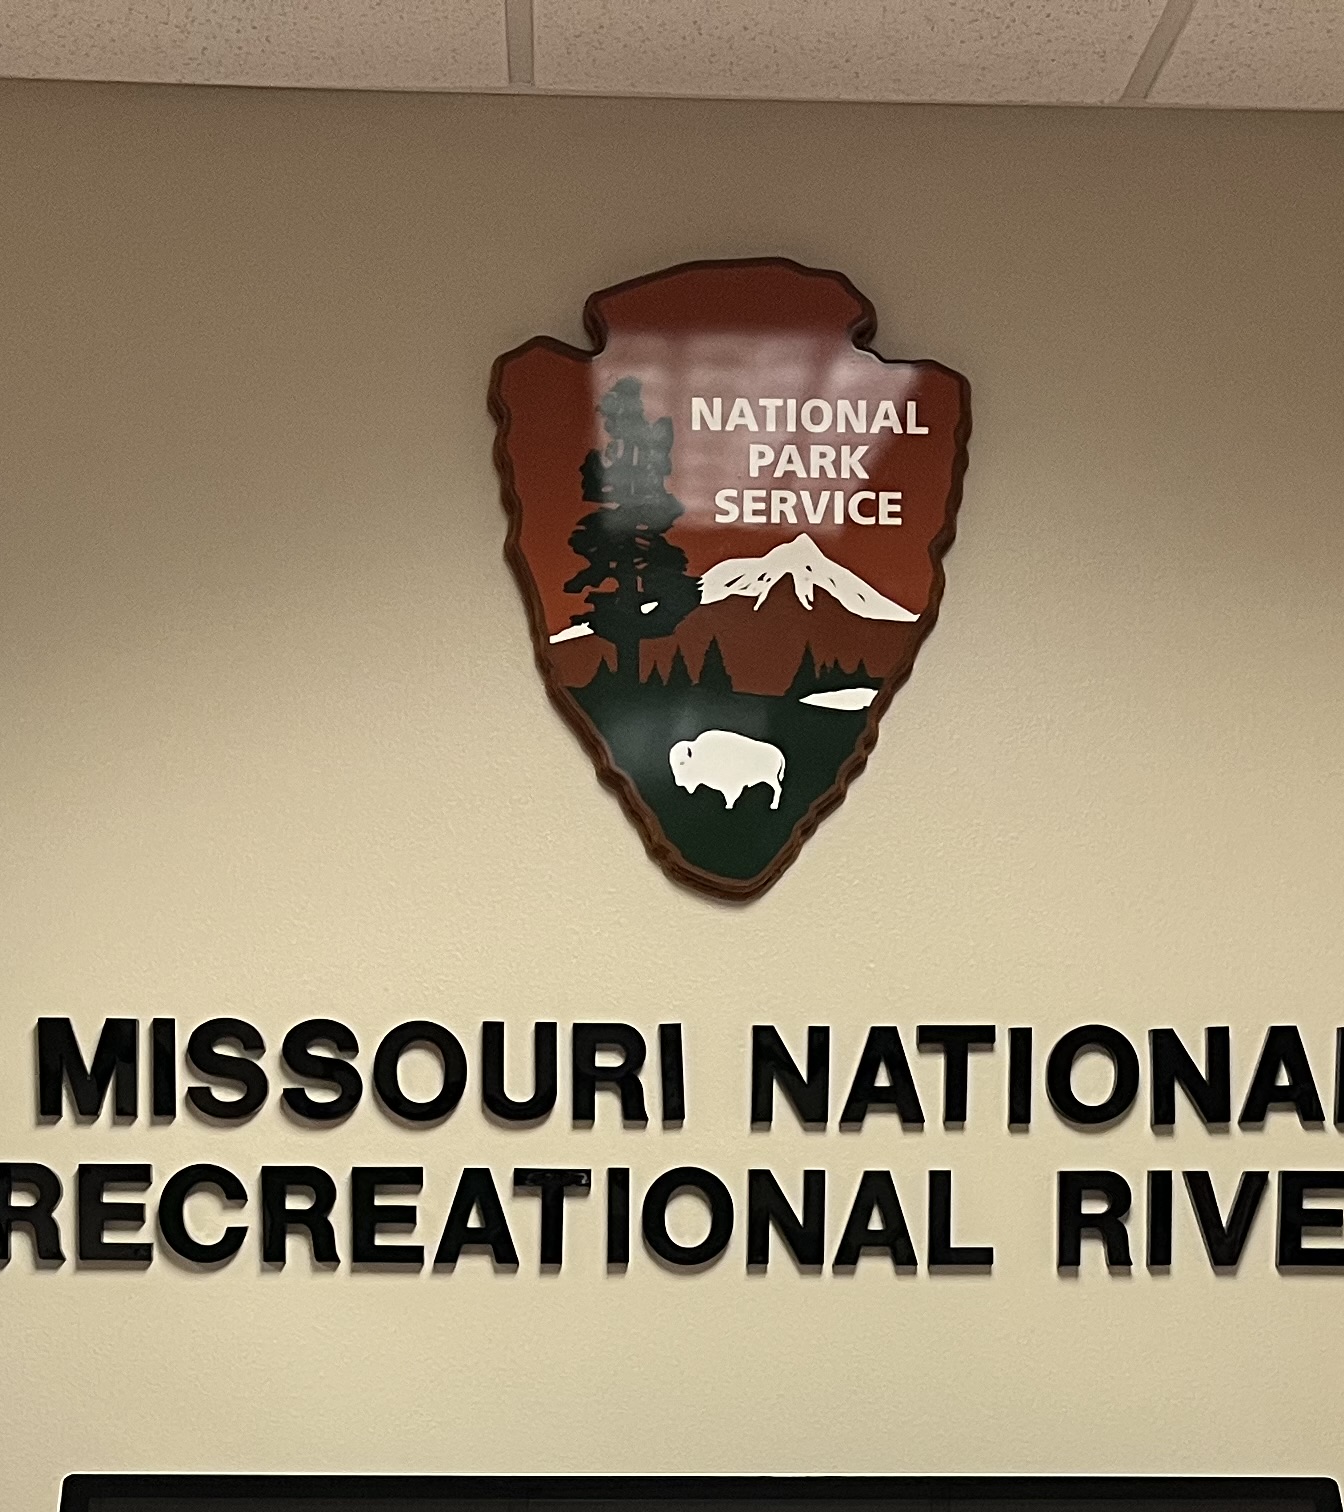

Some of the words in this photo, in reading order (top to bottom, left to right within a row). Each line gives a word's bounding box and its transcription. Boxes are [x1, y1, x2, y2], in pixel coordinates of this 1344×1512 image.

[691, 396, 929, 435] NATIONAL
[748, 443, 870, 480] PARK
[713, 489, 903, 526] SERVICE
[35, 1015, 686, 1128] MISSOURI
